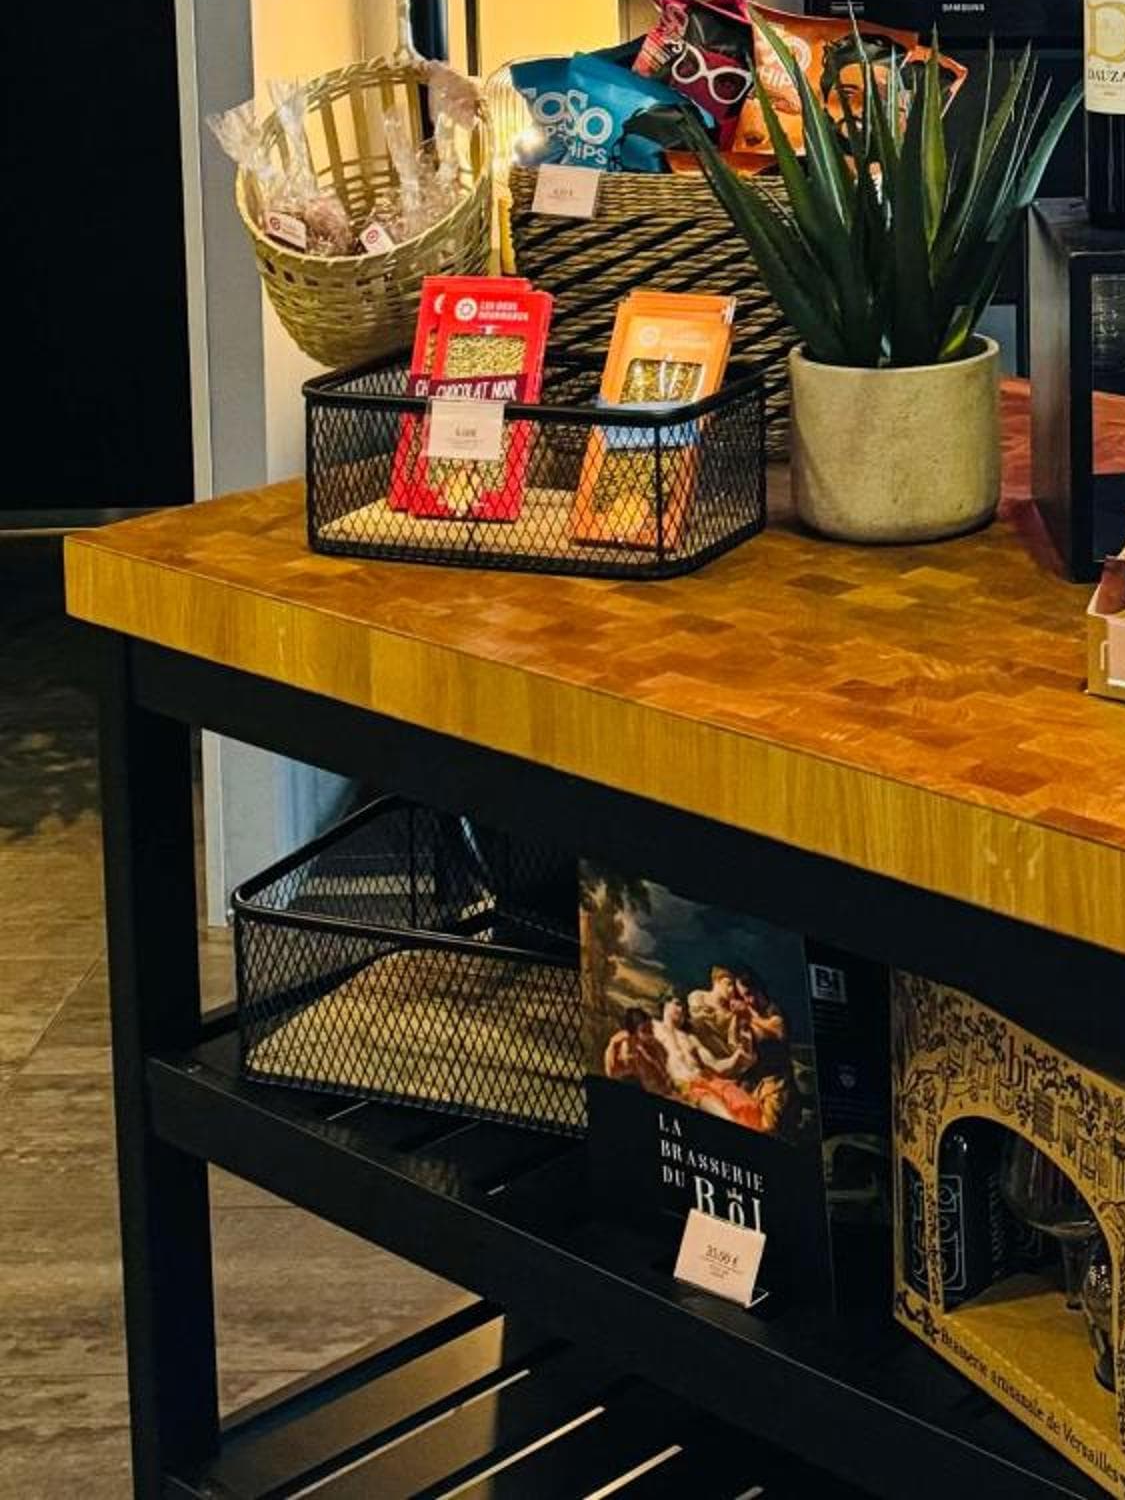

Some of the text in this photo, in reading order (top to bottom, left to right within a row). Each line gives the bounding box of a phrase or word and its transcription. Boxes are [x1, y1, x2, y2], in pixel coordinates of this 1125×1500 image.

[491, 379, 518, 400] NOIR
[658, 1111, 682, 1138] LA
[660, 1138, 765, 1193] BRASSERIE
[662, 1164, 686, 1188] DU
[1061, 1422, 1119, 1483] Versailles
